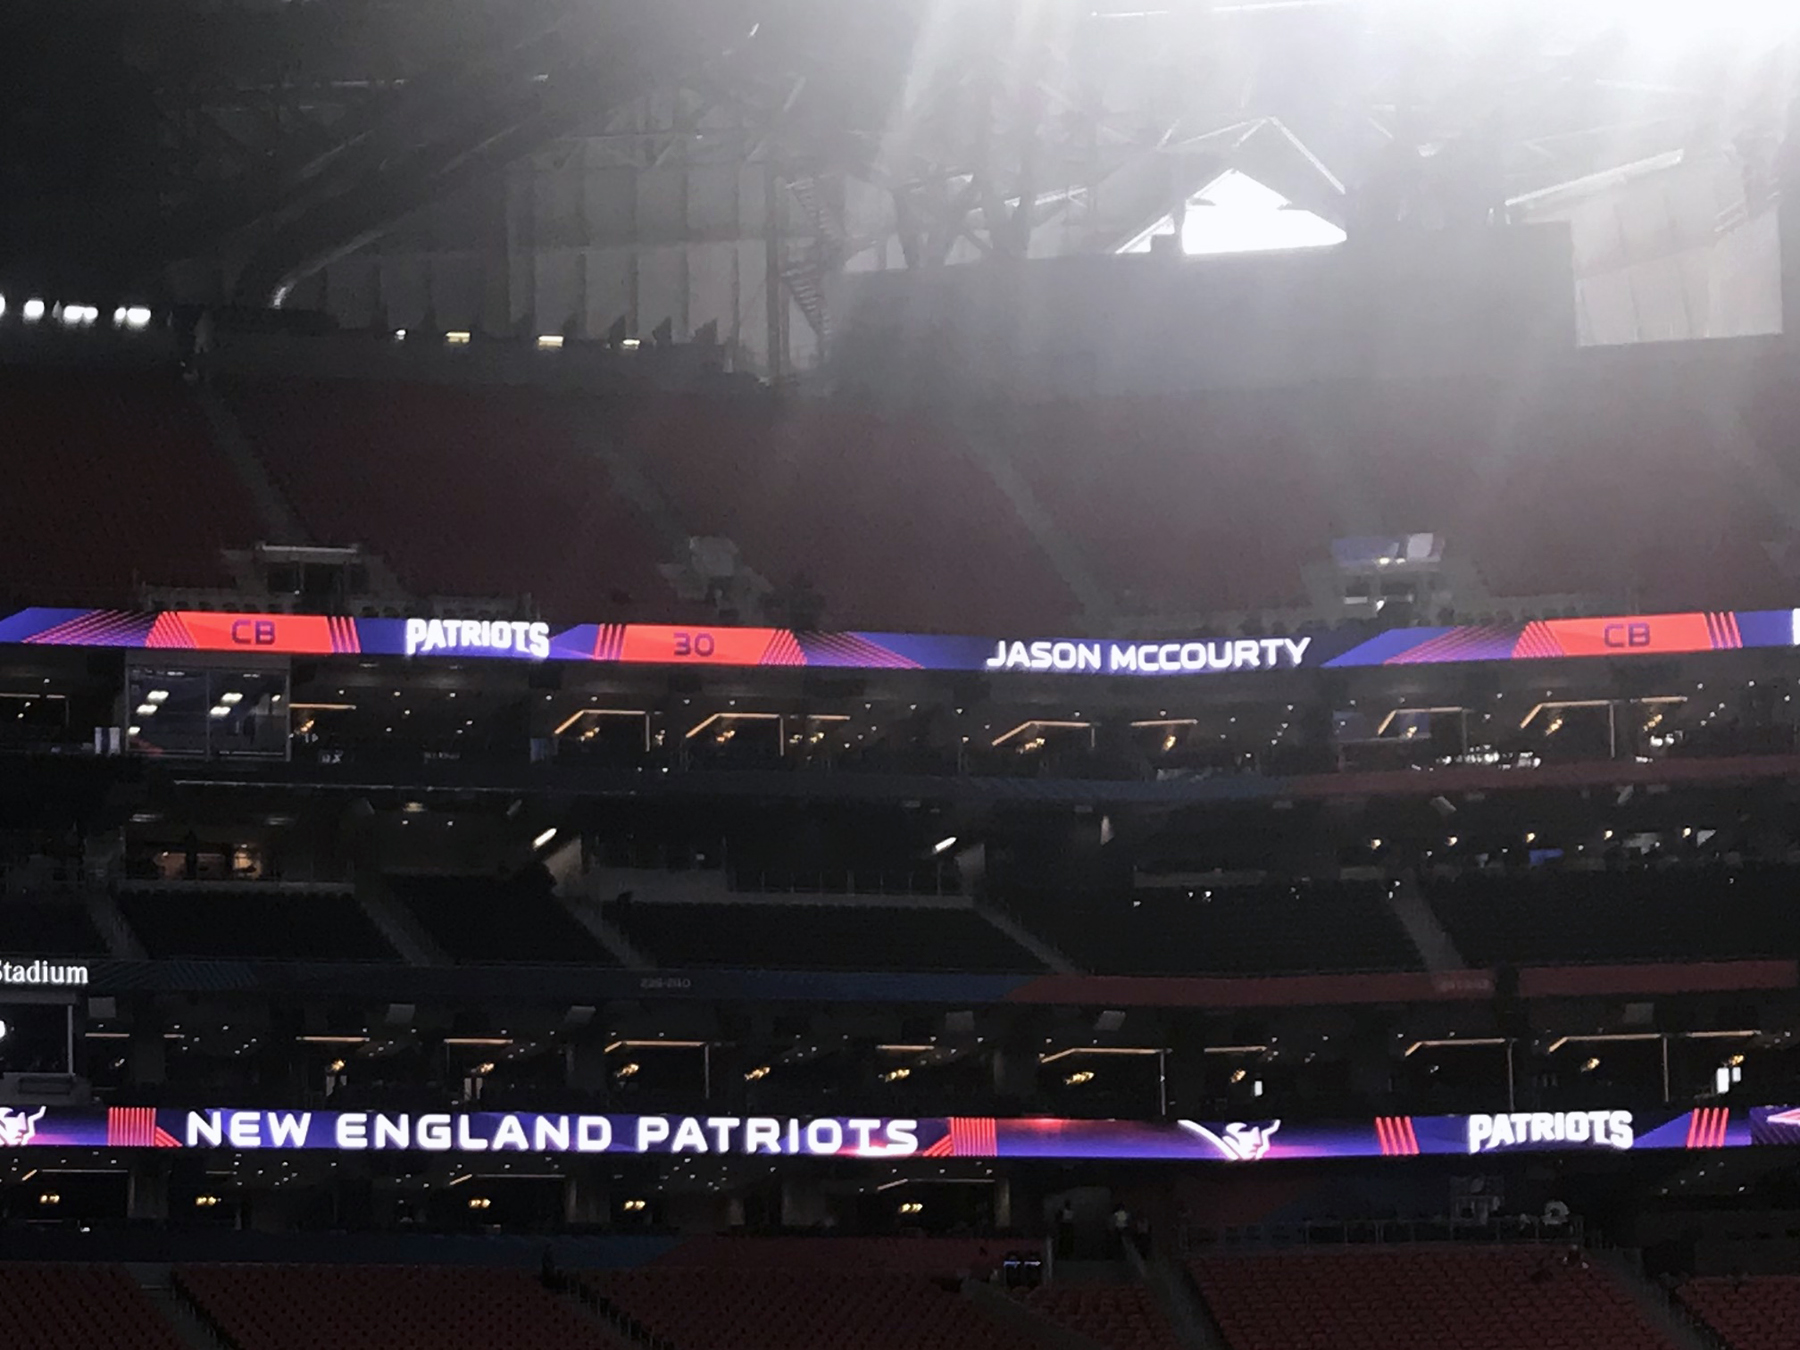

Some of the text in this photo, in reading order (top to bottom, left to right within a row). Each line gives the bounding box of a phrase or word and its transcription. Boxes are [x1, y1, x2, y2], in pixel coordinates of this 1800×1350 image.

[231, 619, 276, 645] CB
[406, 619, 551, 659] PATRIOTS
[673, 633, 715, 658] 30
[1604, 623, 1651, 649] CB
[986, 637, 1312, 674] JASON MCCOURTY
[188, 1111, 919, 1157] NEW ENGLAND PATRIOTS
[1468, 1111, 1634, 1152] PATRIOTS
